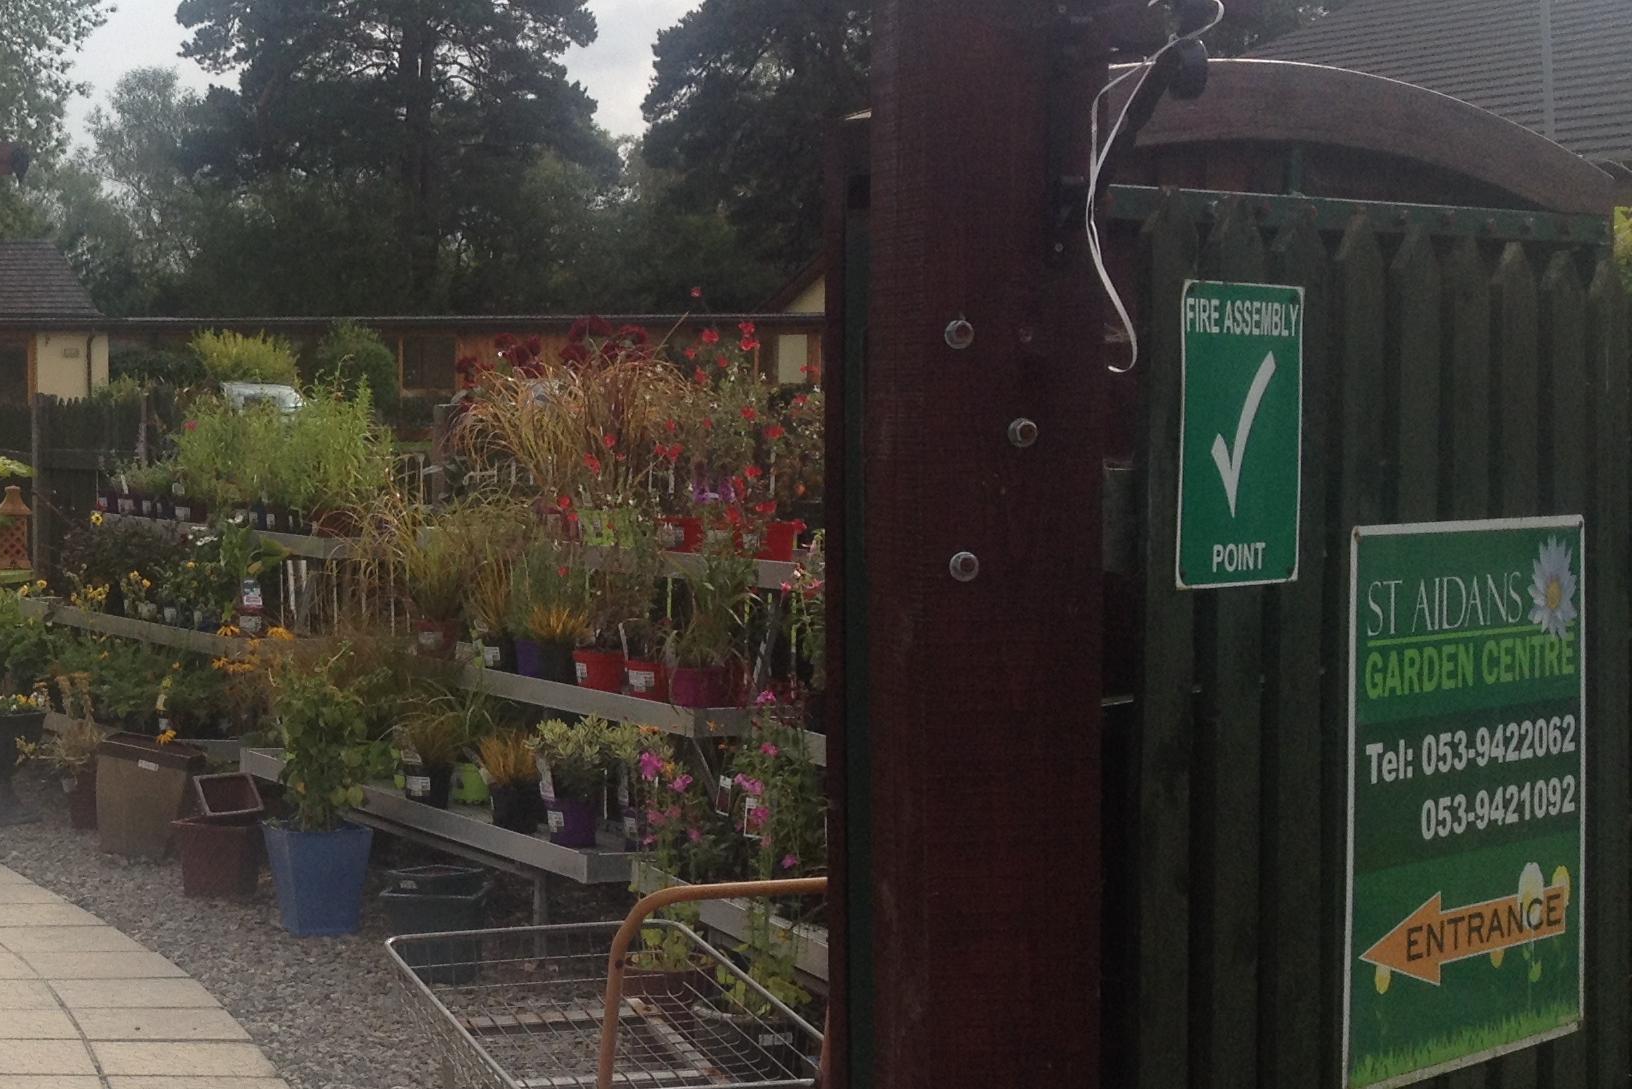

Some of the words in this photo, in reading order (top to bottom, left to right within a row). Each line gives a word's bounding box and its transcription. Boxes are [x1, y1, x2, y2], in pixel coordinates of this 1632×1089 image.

[1186, 298, 1220, 333] FIRE
[1223, 300, 1299, 337] ASSEMBLY
[1212, 542, 1266, 573] POINT
[1367, 580, 1402, 636] ST
[1412, 571, 1522, 633] AIDANS
[1365, 642, 1474, 700] GARDEN
[1481, 631, 1575, 685] CENTRE
[1366, 739, 1413, 785] Tel:
[1422, 714, 1576, 775] 053-9422062
[1421, 774, 1576, 840] 053-9421092
[1406, 893, 1562, 962] ENTRANCE
